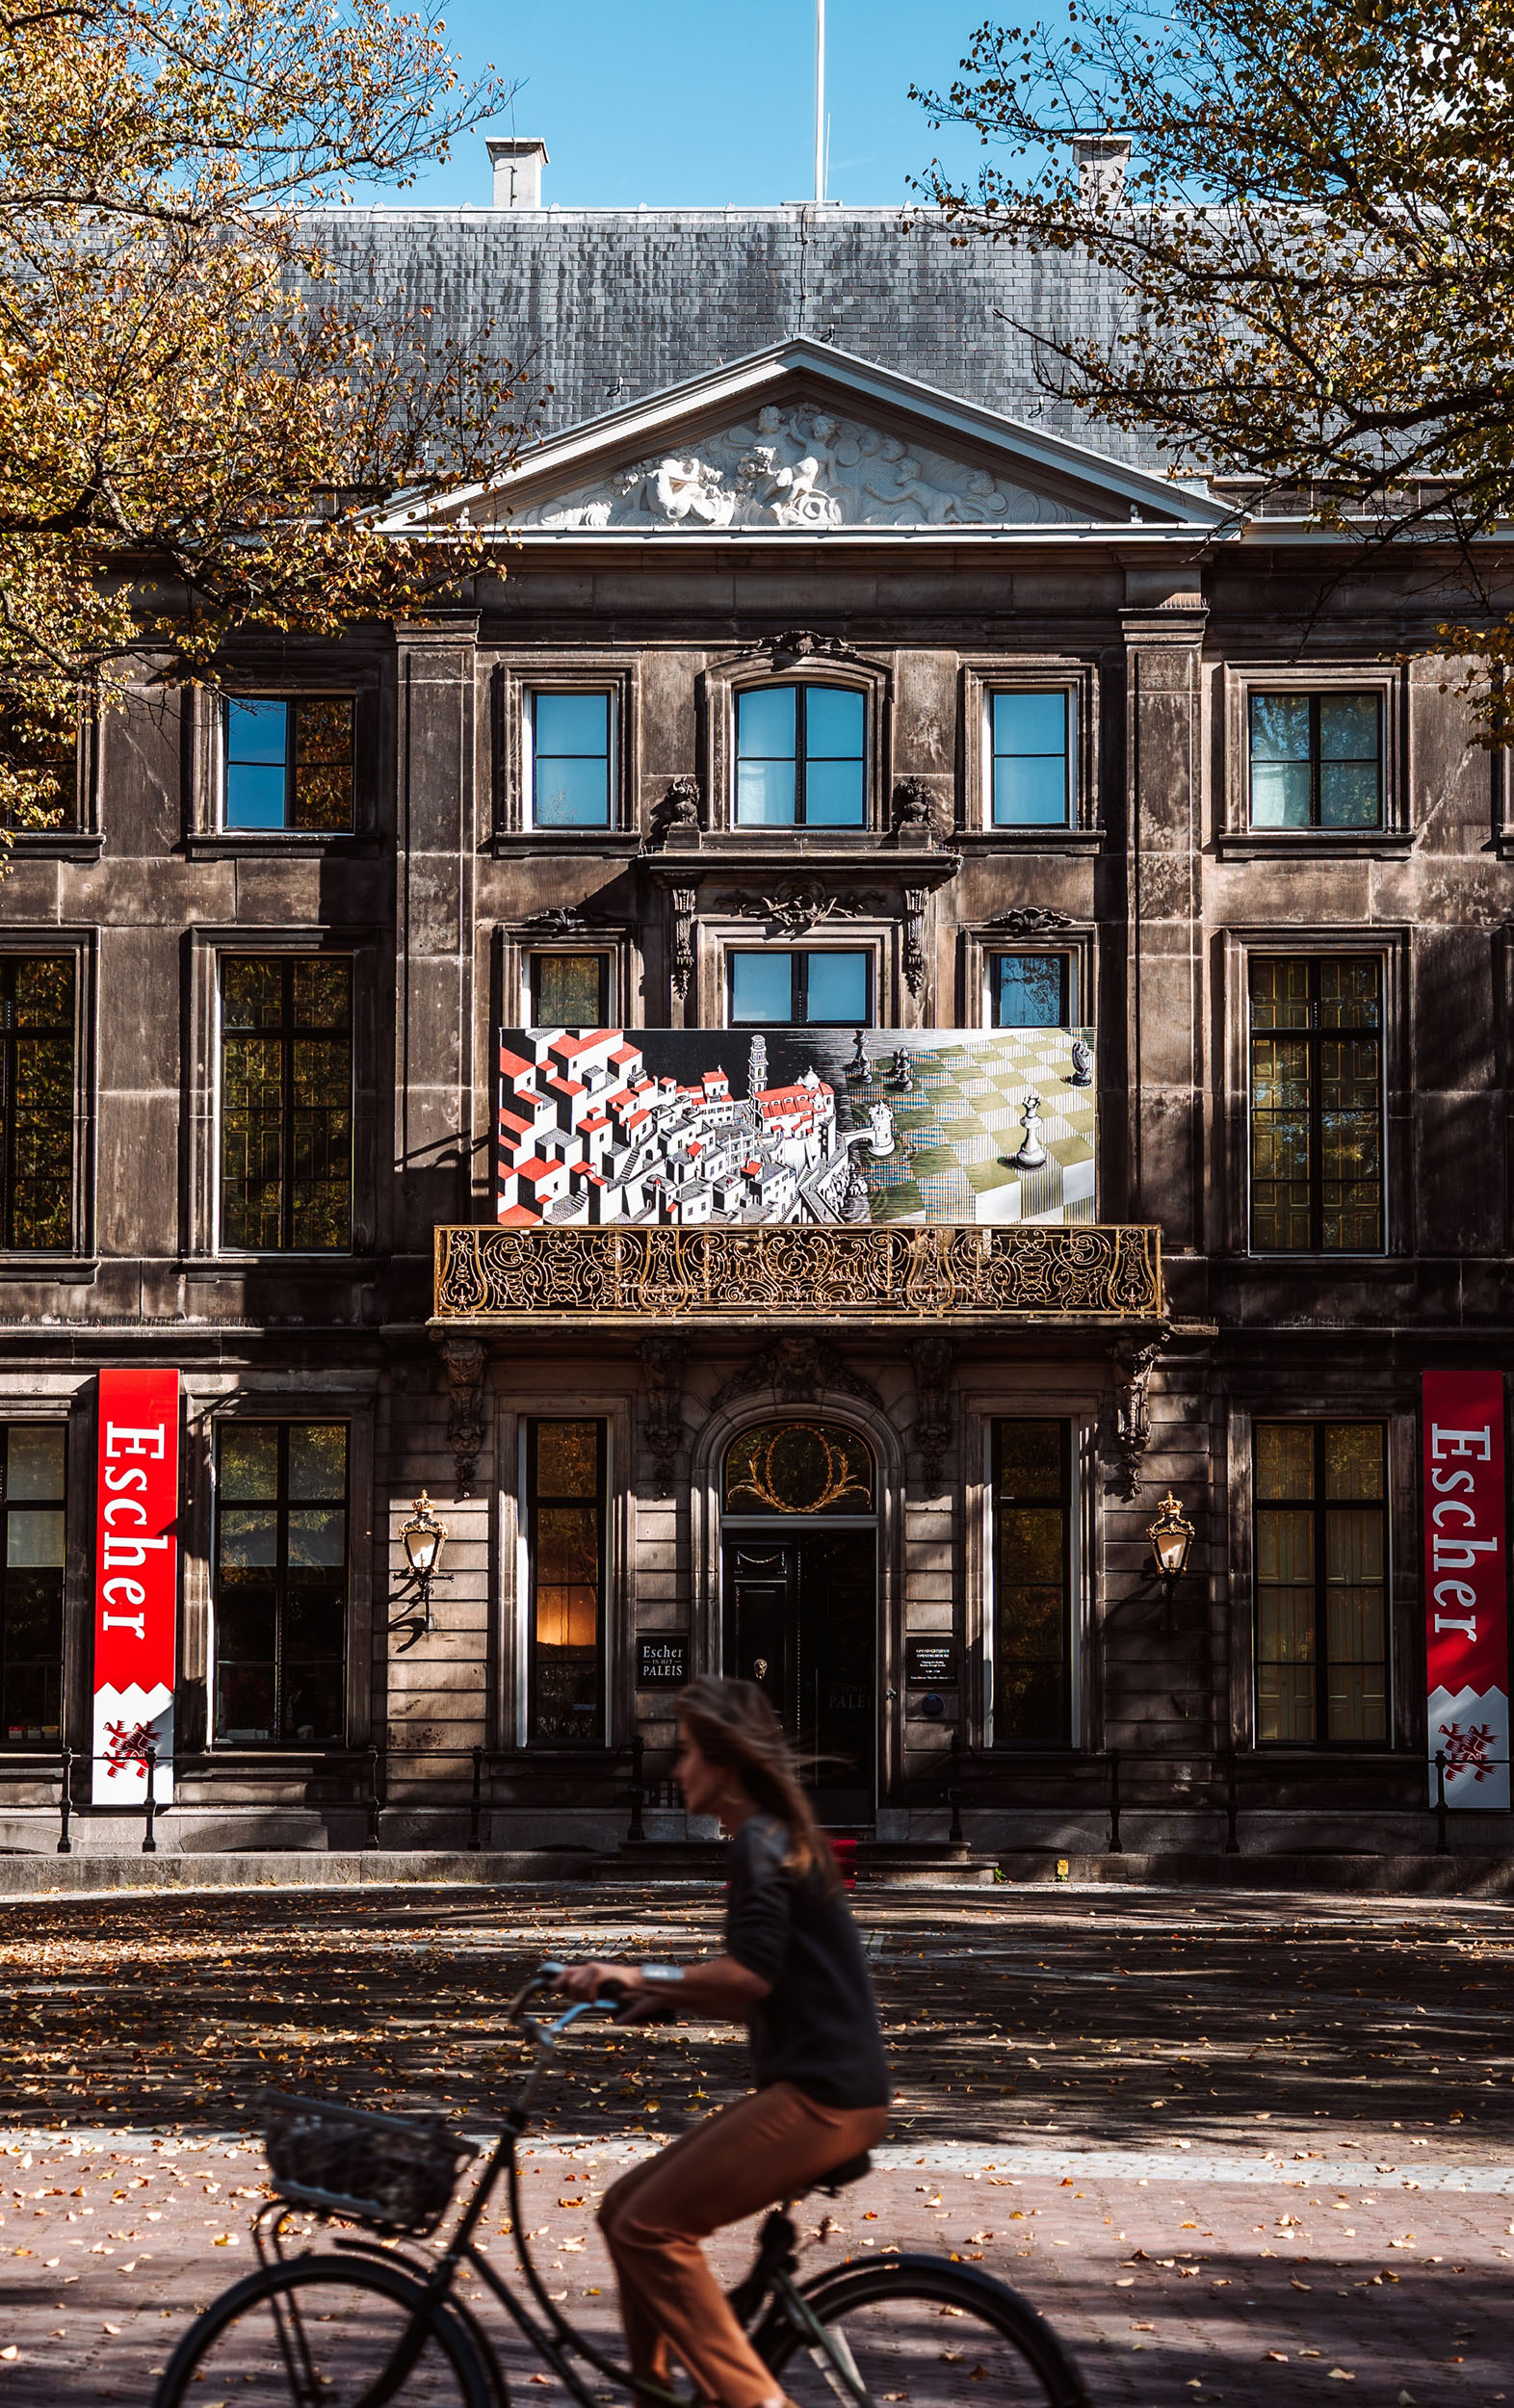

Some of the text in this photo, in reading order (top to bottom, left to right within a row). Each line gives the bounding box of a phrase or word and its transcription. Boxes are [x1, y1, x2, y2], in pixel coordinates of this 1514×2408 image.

[102, 1421, 168, 1640] Escher
[1431, 1423, 1498, 1642] Escher
[643, 1644, 683, 1658] Escher
[643, 1665, 683, 1676] PALEIS
[829, 1695, 871, 1708] PALEI
